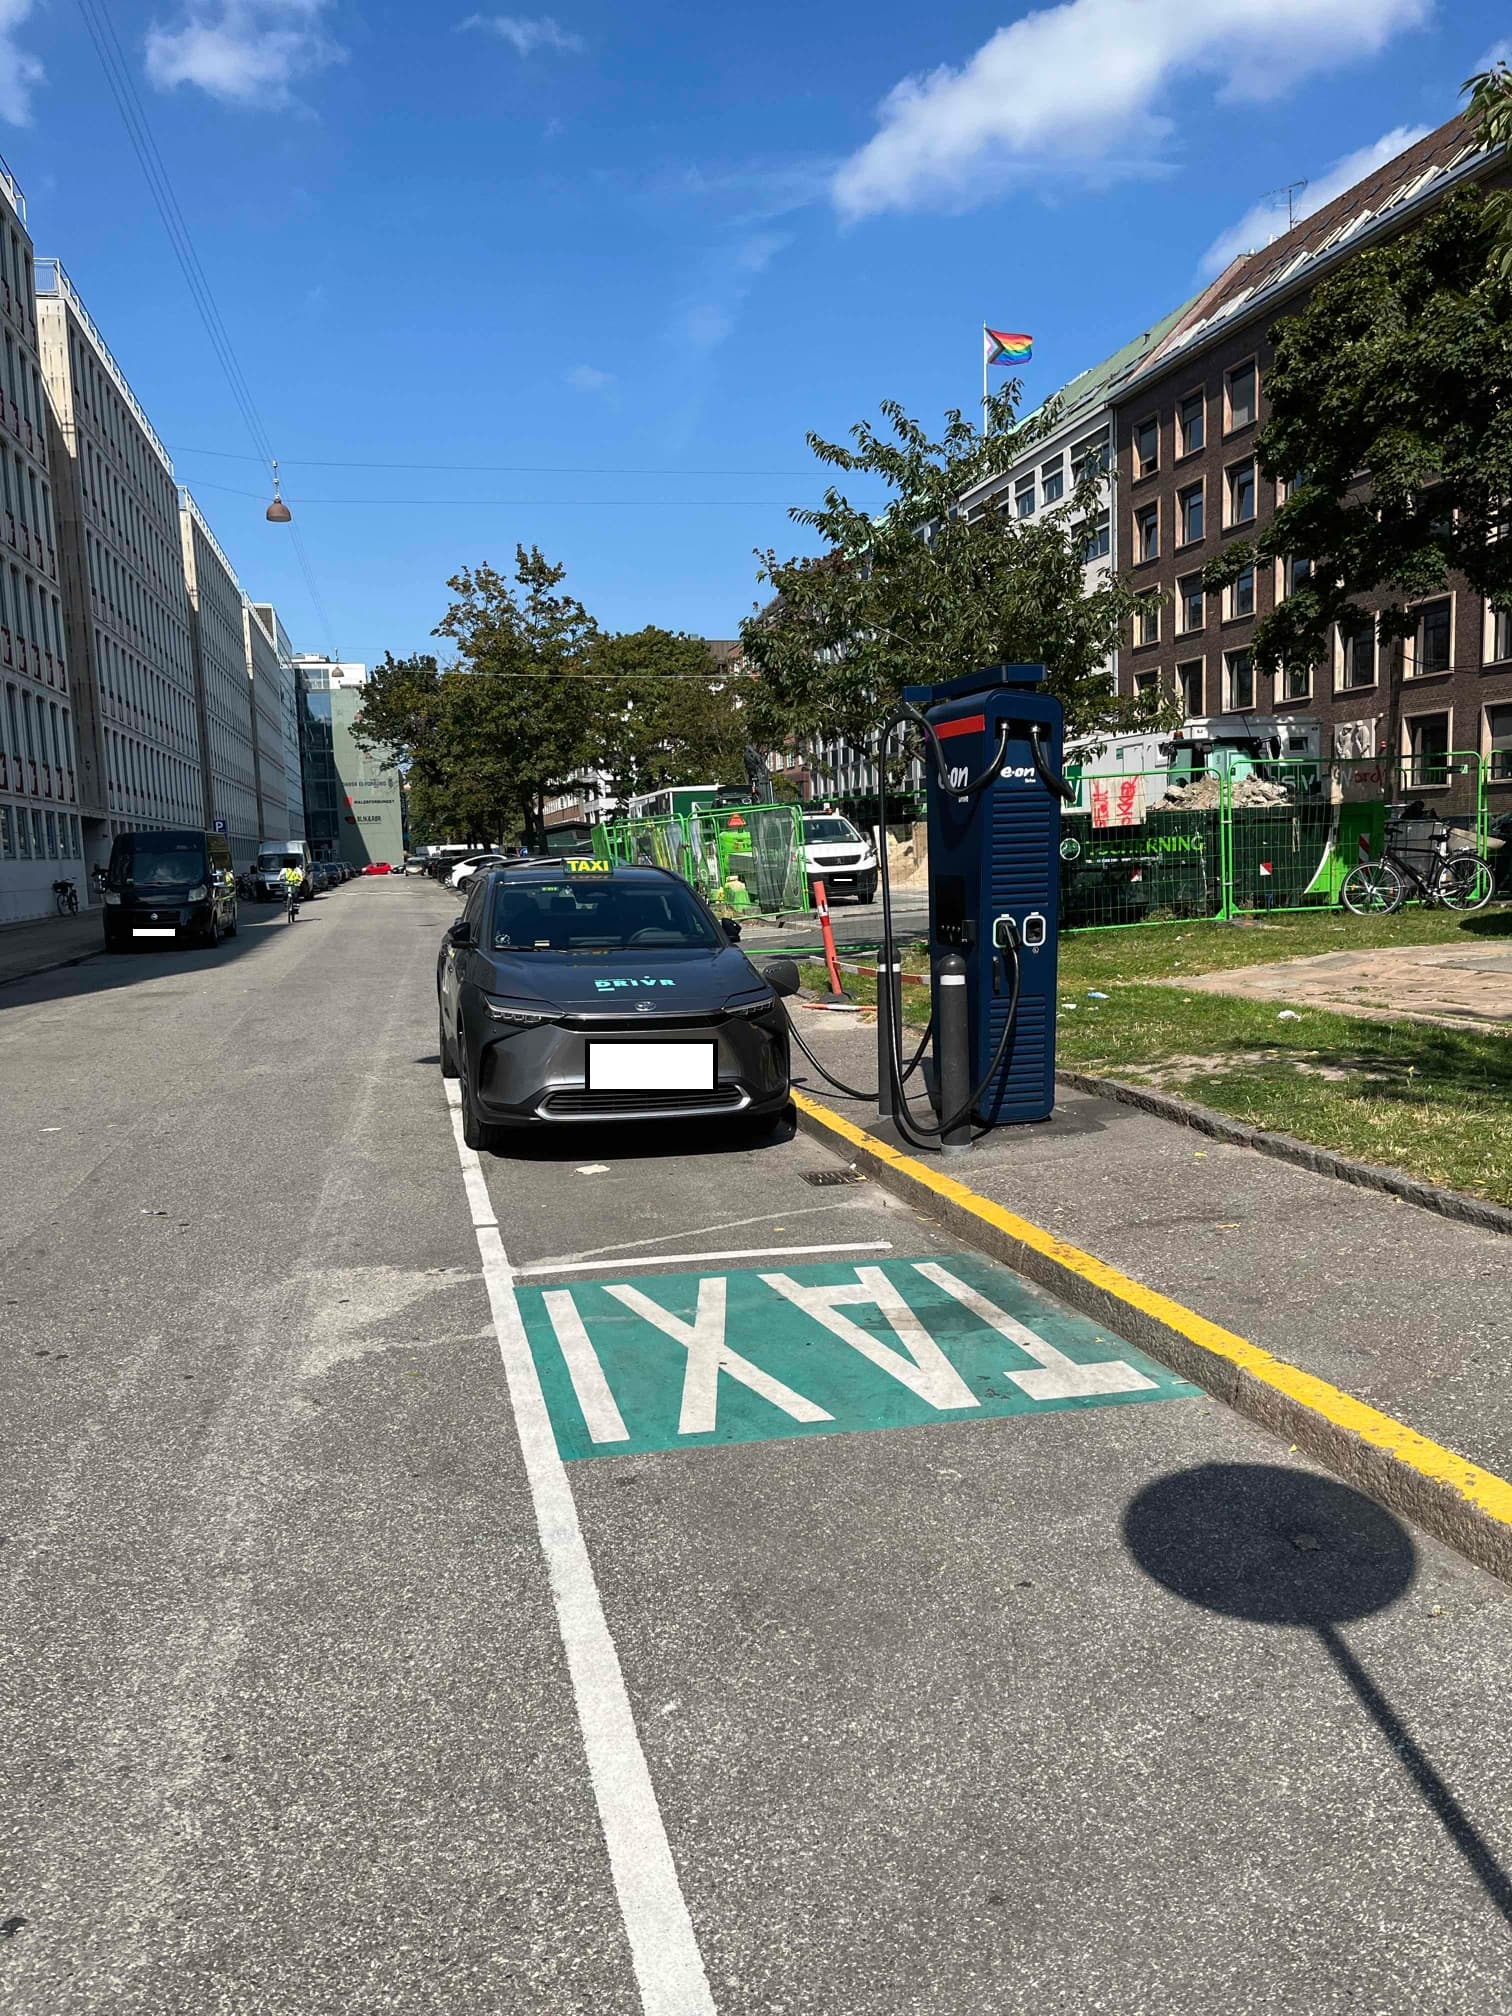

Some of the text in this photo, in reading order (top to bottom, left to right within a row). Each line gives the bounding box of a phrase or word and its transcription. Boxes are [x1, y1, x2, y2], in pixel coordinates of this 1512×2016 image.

[215, 821, 224, 832] P
[566, 860, 609, 872] TAXI
[542, 1262, 1159, 1444] TAXI
